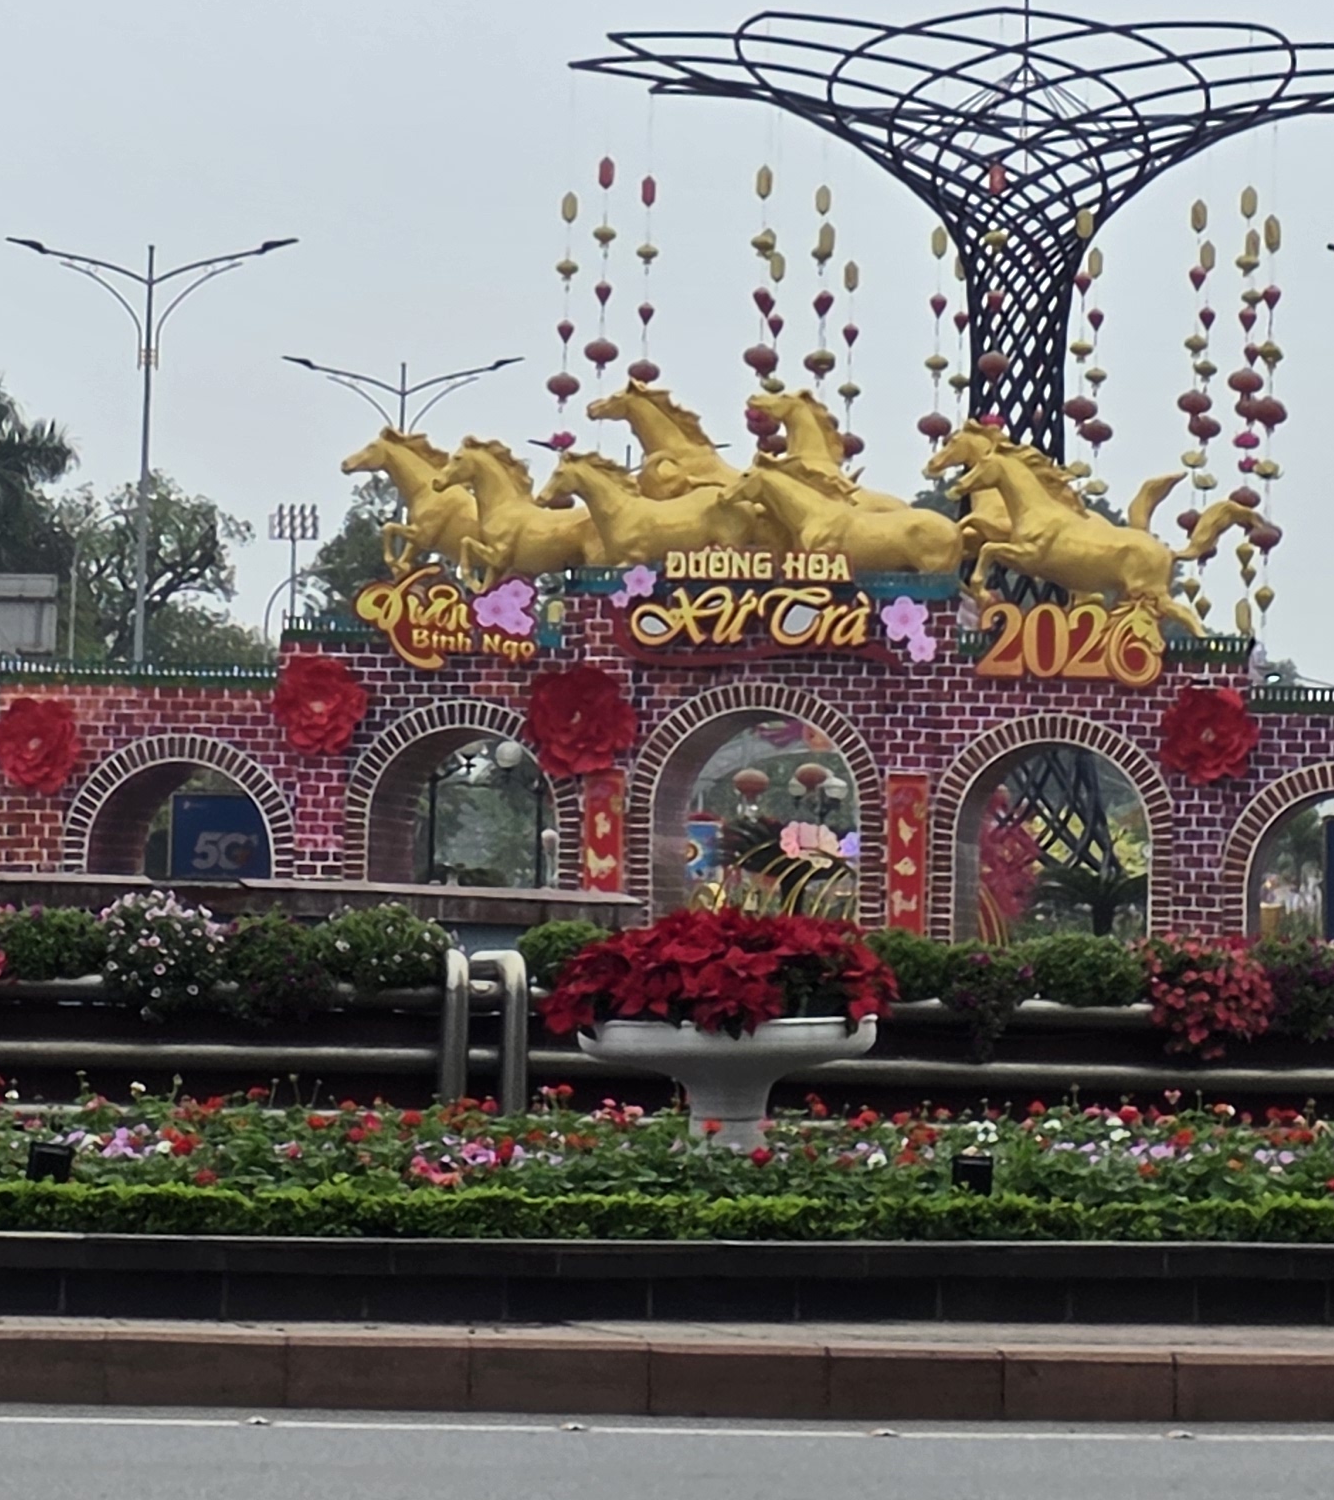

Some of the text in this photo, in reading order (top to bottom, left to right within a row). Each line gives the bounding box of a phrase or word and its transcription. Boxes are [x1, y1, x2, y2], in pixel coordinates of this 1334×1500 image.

[667, 545, 851, 581] ĐƯỜNG HOA
[356, 565, 471, 669] Xuân
[631, 586, 870, 646] Xứ Trà
[976, 598, 1165, 687] 2026
